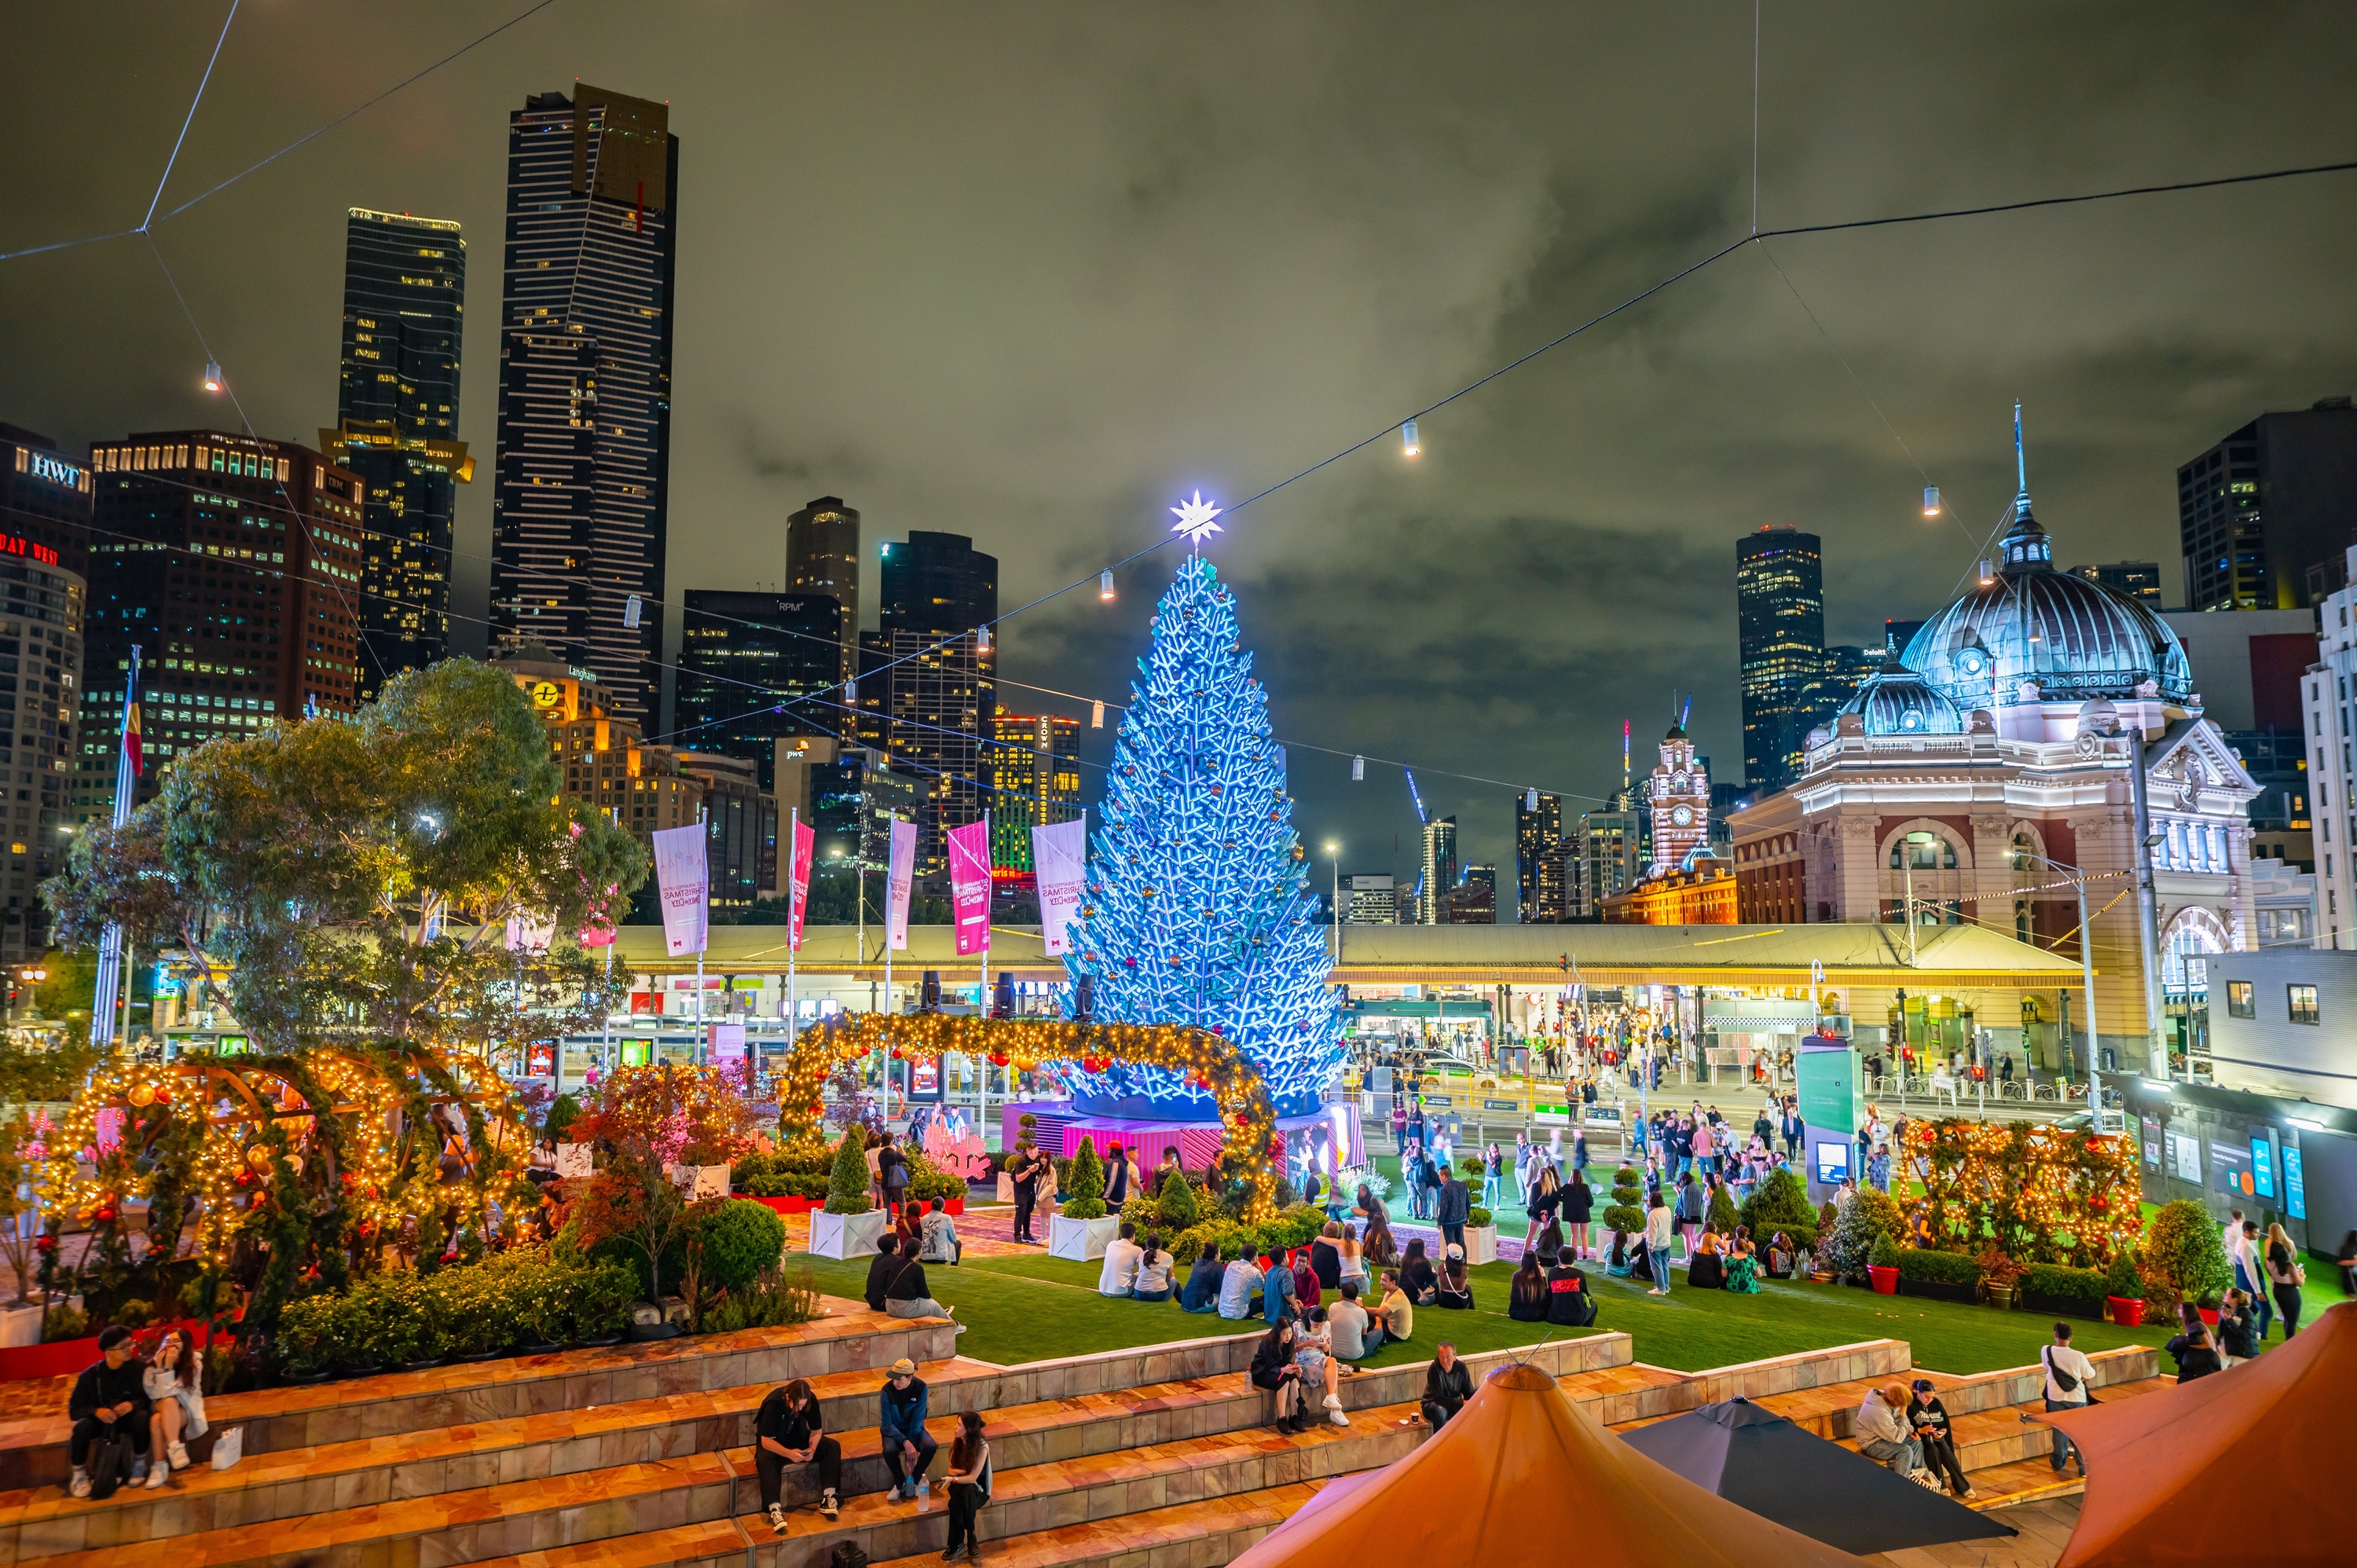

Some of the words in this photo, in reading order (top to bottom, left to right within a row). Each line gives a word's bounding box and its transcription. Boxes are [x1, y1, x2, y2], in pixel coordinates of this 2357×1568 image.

[32, 453, 79, 486] HWT
[328, 476, 343, 491] IBM
[569, 664, 597, 683] Langham
[786, 750, 804, 760] pwc
